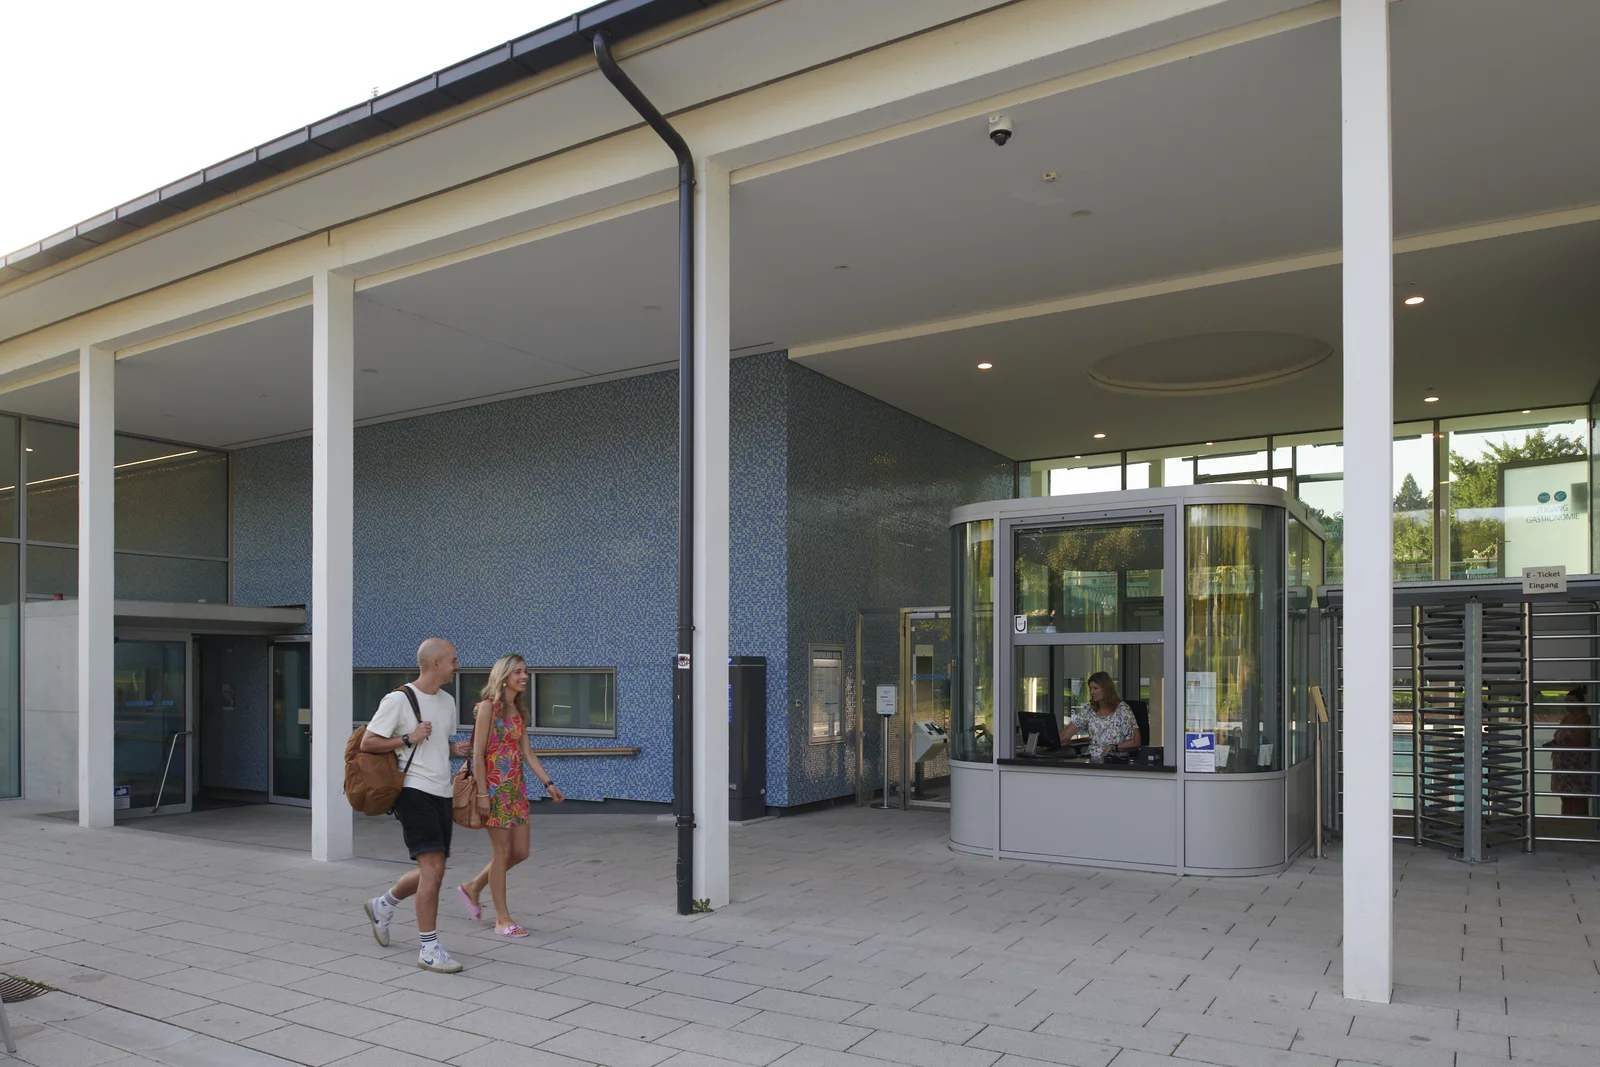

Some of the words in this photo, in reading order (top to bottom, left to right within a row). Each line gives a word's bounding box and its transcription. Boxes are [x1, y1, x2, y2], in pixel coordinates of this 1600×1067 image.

[1537, 505, 1568, 514] ZUGANG
[1526, 513, 1579, 523] GASTRONOMIE
[1529, 582, 1559, 590] Eingang
